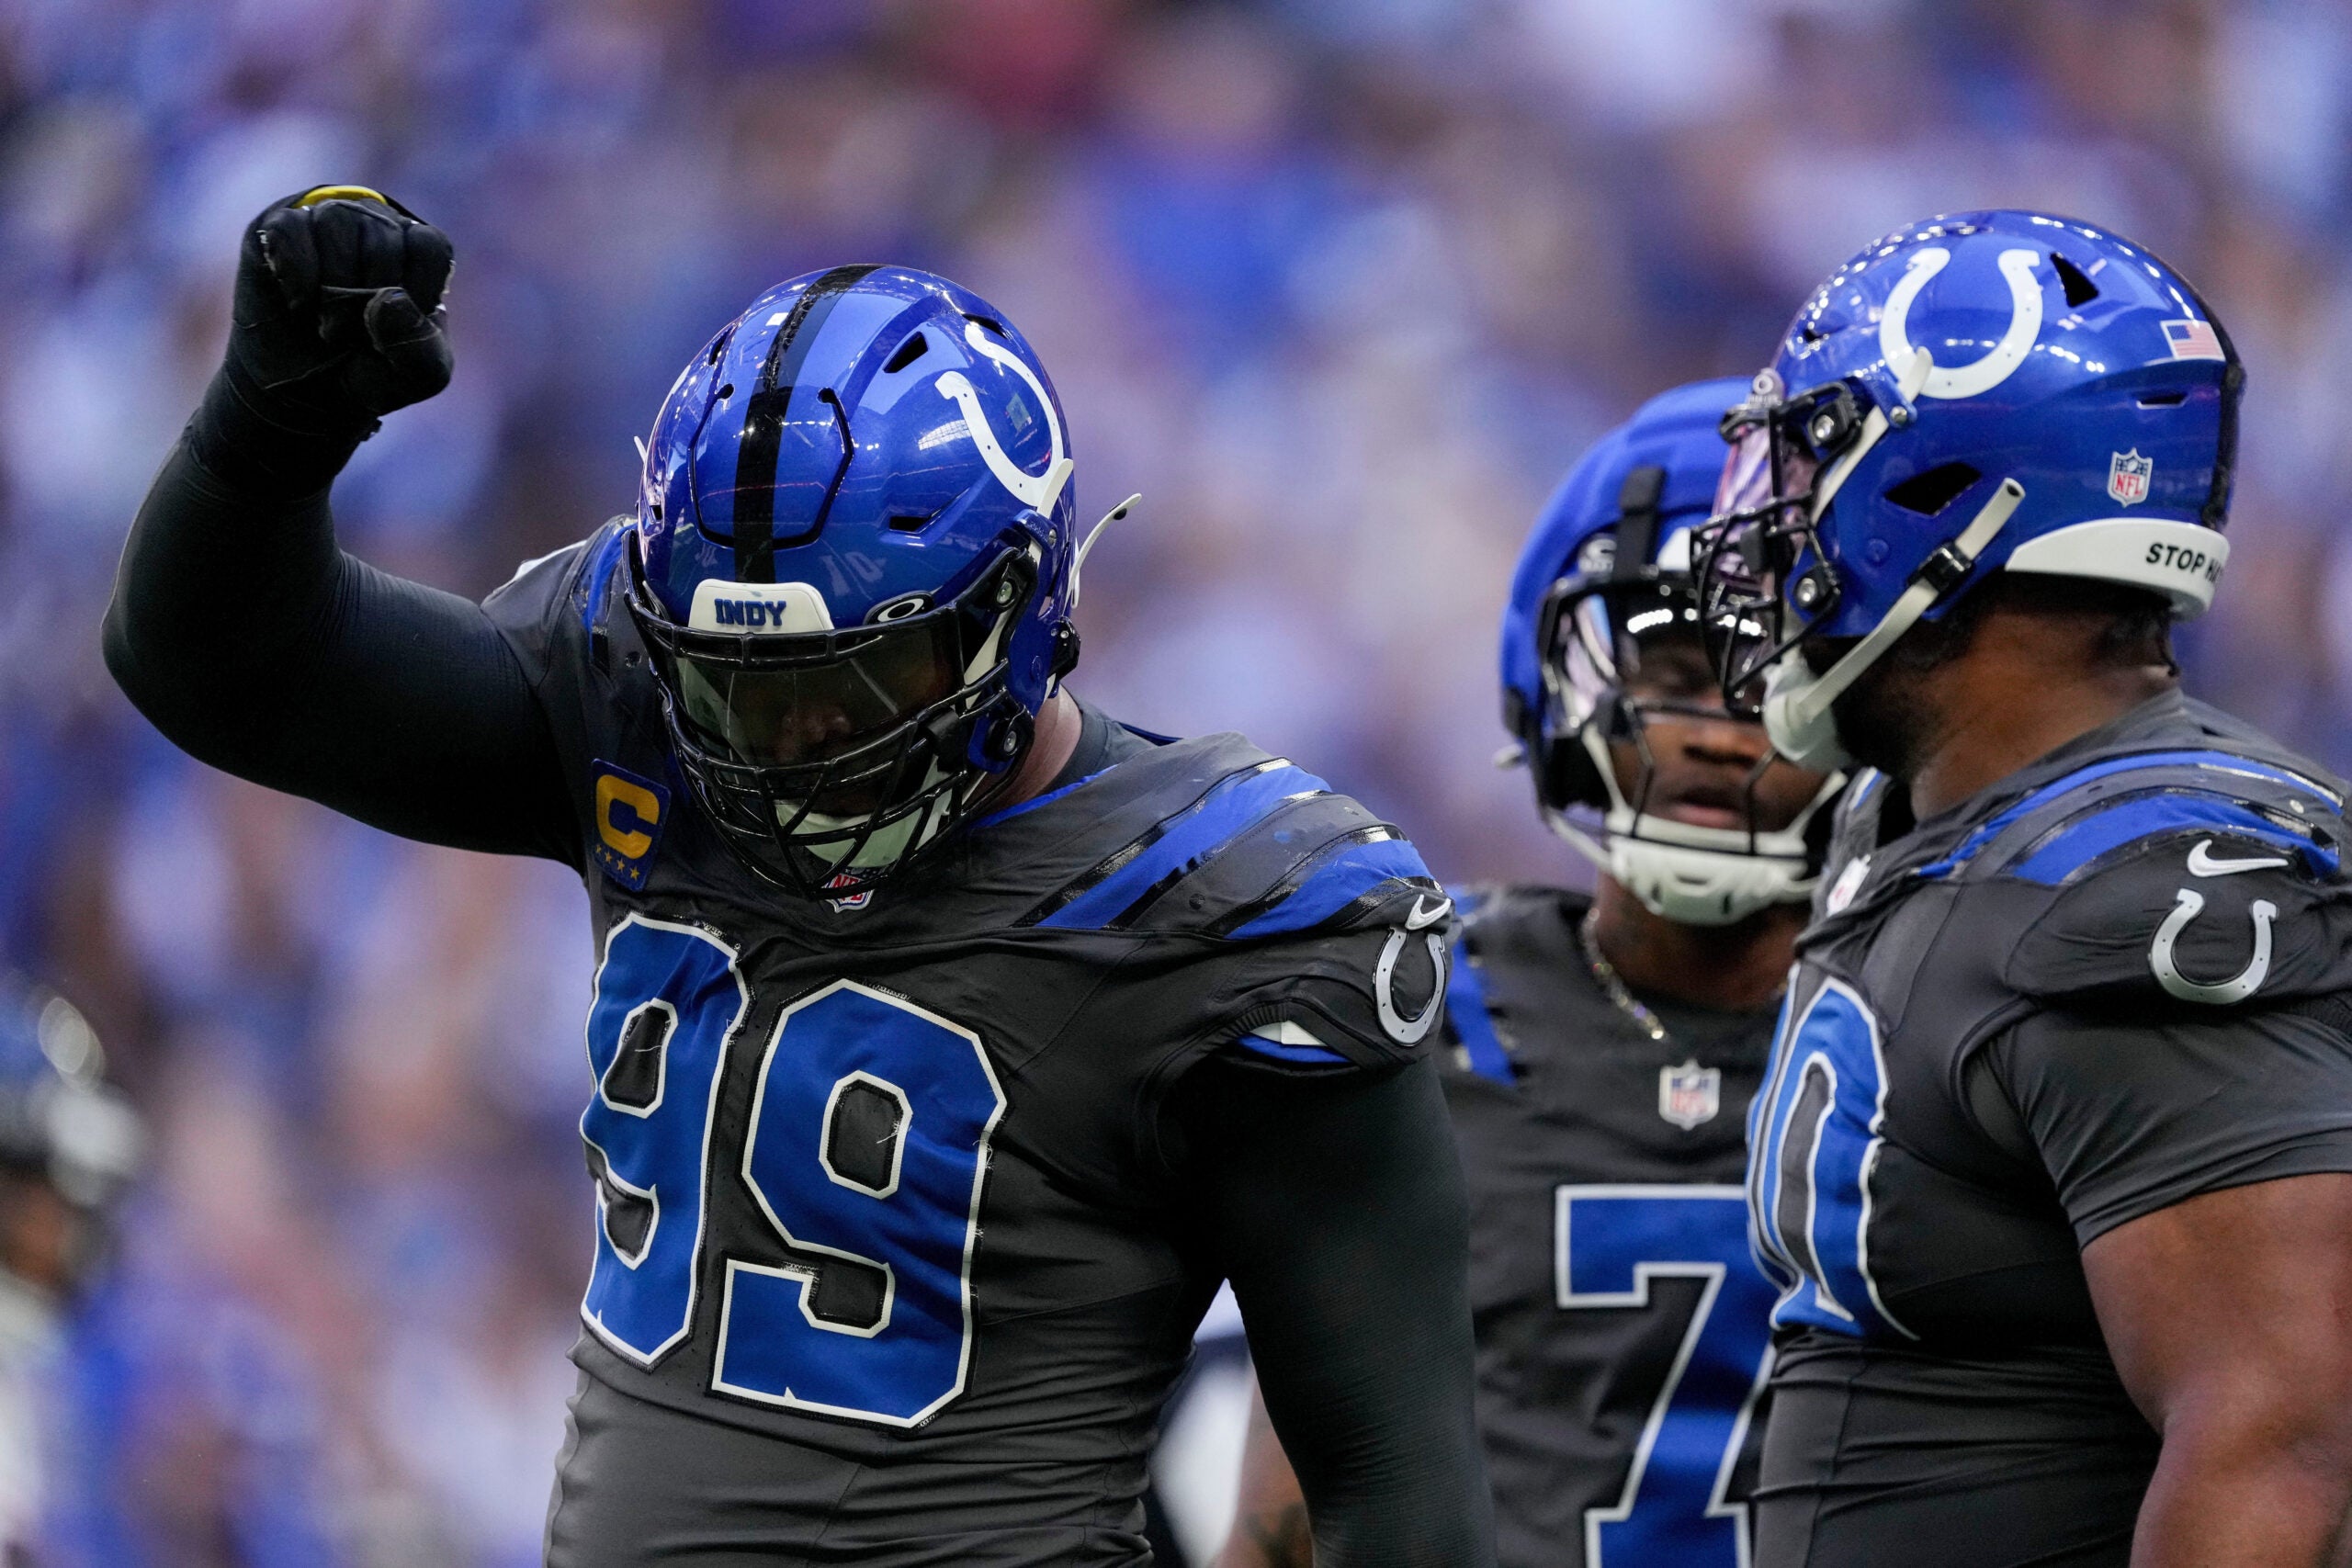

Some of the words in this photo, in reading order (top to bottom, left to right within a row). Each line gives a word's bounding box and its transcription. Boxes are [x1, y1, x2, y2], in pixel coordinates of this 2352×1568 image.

[2115, 472, 2143, 496] NFL
[2145, 542, 2206, 574] STOP
[714, 598, 786, 626] INDY
[595, 773, 660, 860] C
[580, 911, 1007, 1429] 99
[1555, 1183, 1779, 1568] 7
